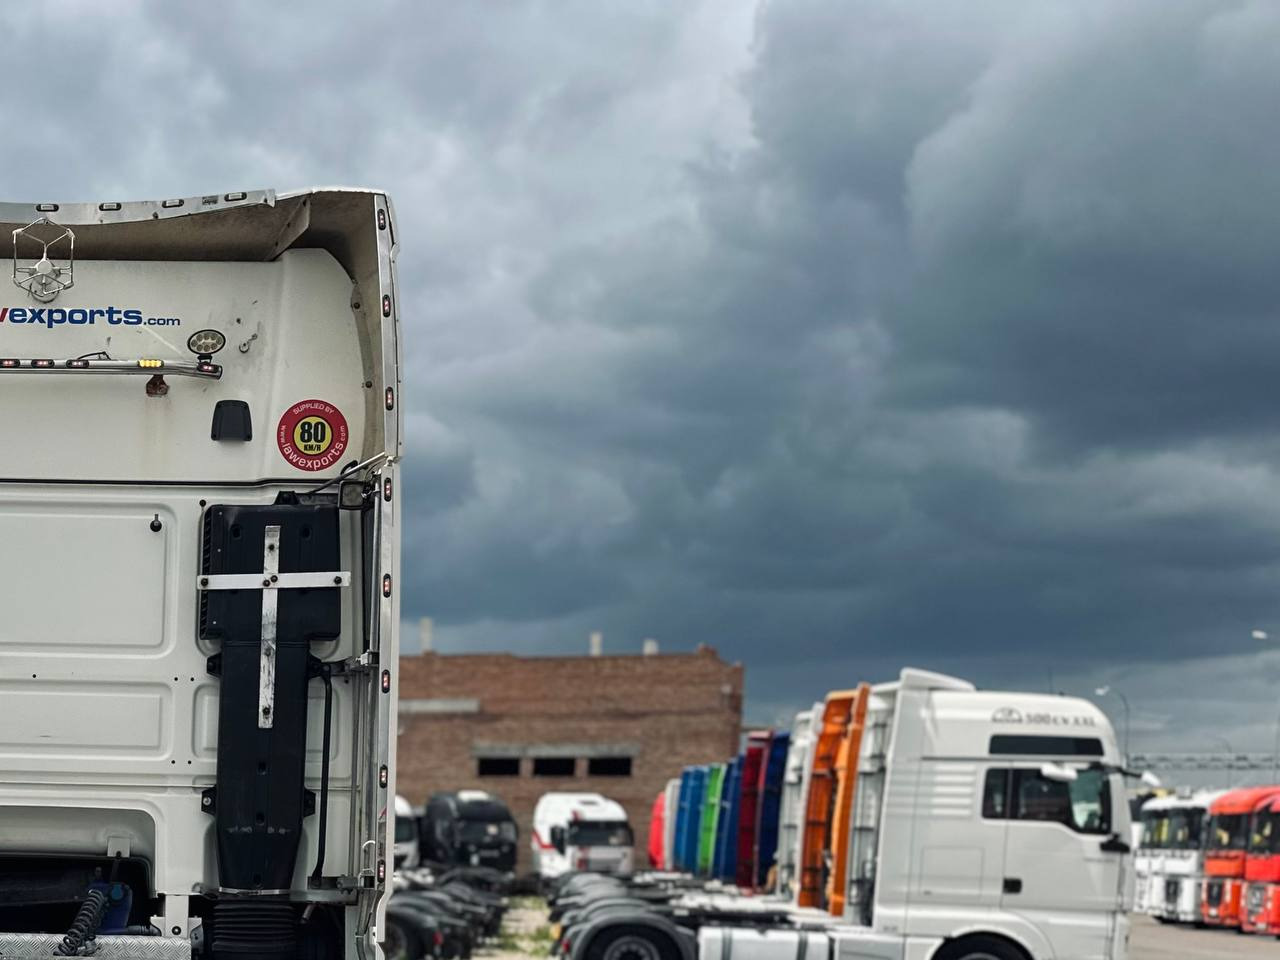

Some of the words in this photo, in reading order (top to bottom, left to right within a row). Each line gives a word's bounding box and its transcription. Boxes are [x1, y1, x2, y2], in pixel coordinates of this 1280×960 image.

[293, 402, 325, 415] SUPPLIED
[324, 406, 335, 414] BY
[300, 421, 326, 443] 80
